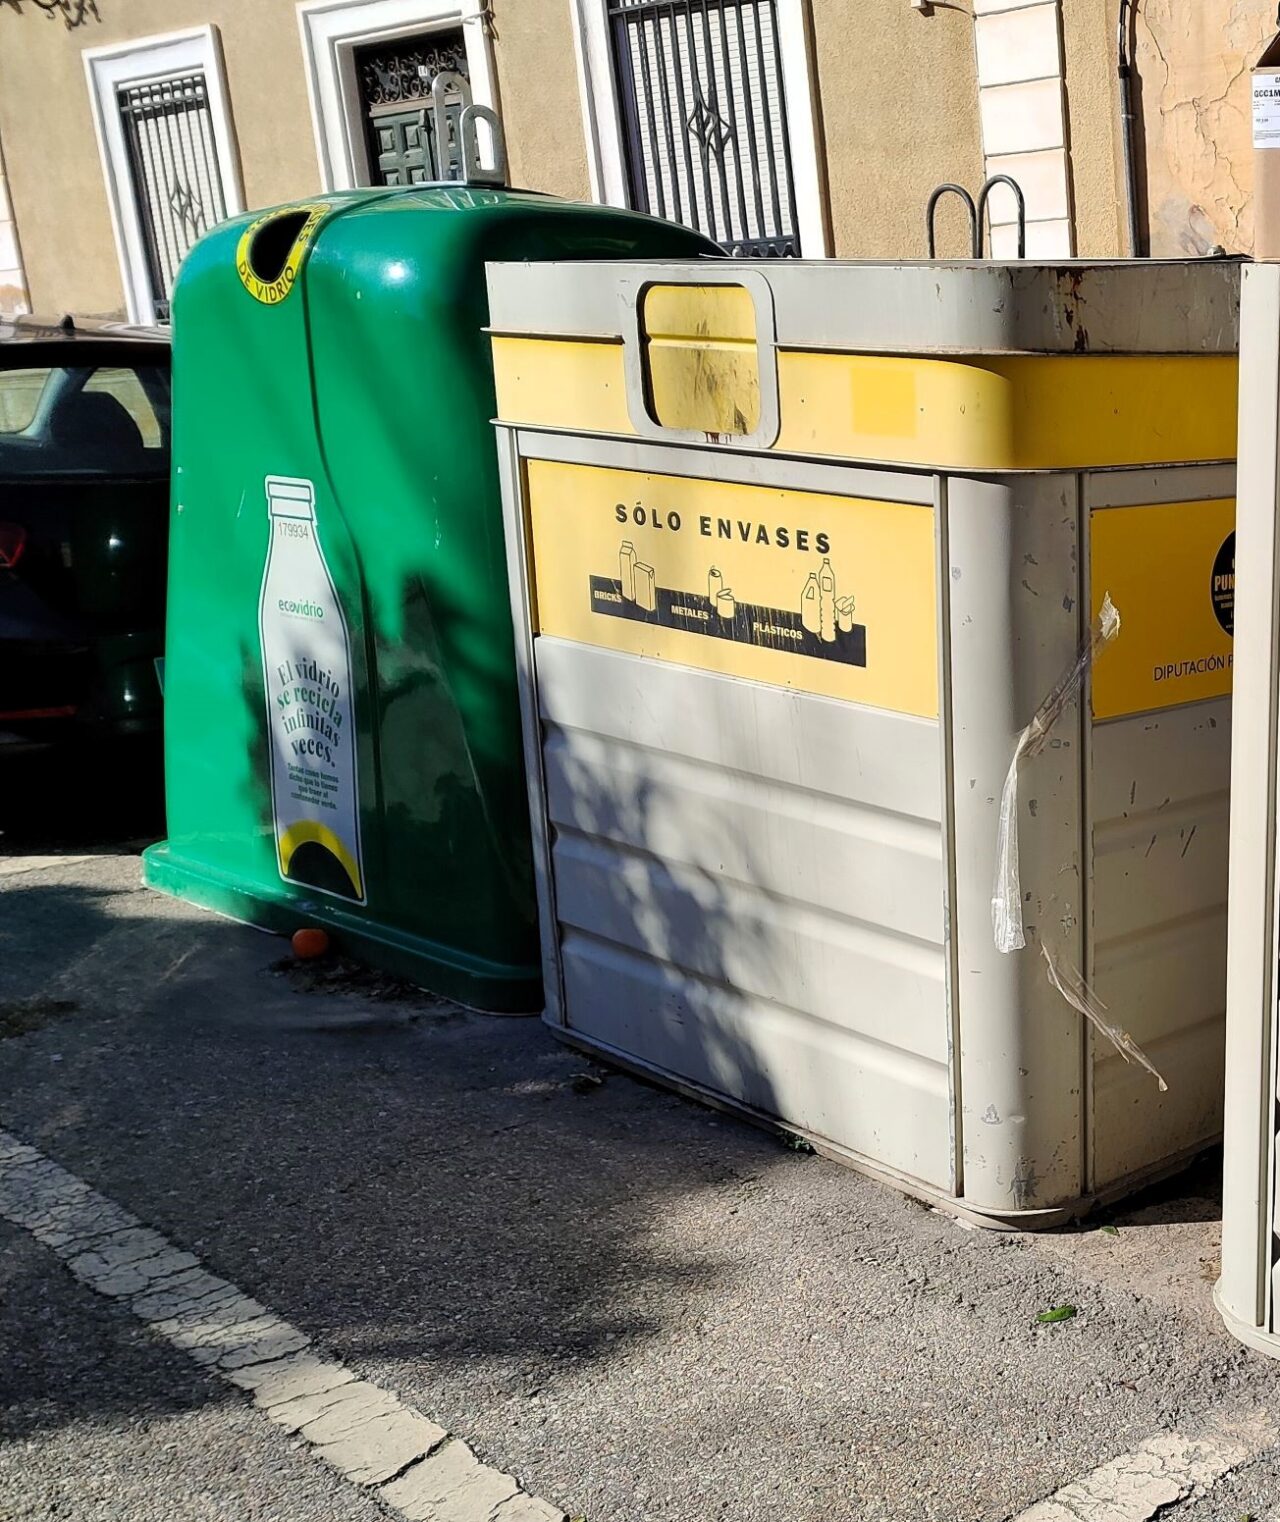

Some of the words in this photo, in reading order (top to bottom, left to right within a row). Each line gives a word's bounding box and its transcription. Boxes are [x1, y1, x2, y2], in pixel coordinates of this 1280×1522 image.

[238, 260, 252, 287] DE
[256, 265, 294, 302] VIDRIO
[615, 501, 681, 531] SÓLO
[700, 515, 830, 554] ENVASES
[279, 598, 323, 618] ecovidrio
[594, 590, 622, 603] BRICKS
[671, 605, 709, 621] METALES
[753, 621, 803, 640] PLÁSTICOS
[277, 660, 294, 686] El
[295, 657, 340, 698] vidrio
[1154, 655, 1225, 682] DIPUTACIÓN
[276, 690, 291, 711] se
[294, 686, 343, 728] recicla
[282, 708, 340, 748] infinitas
[291, 738, 336, 768] veces.
